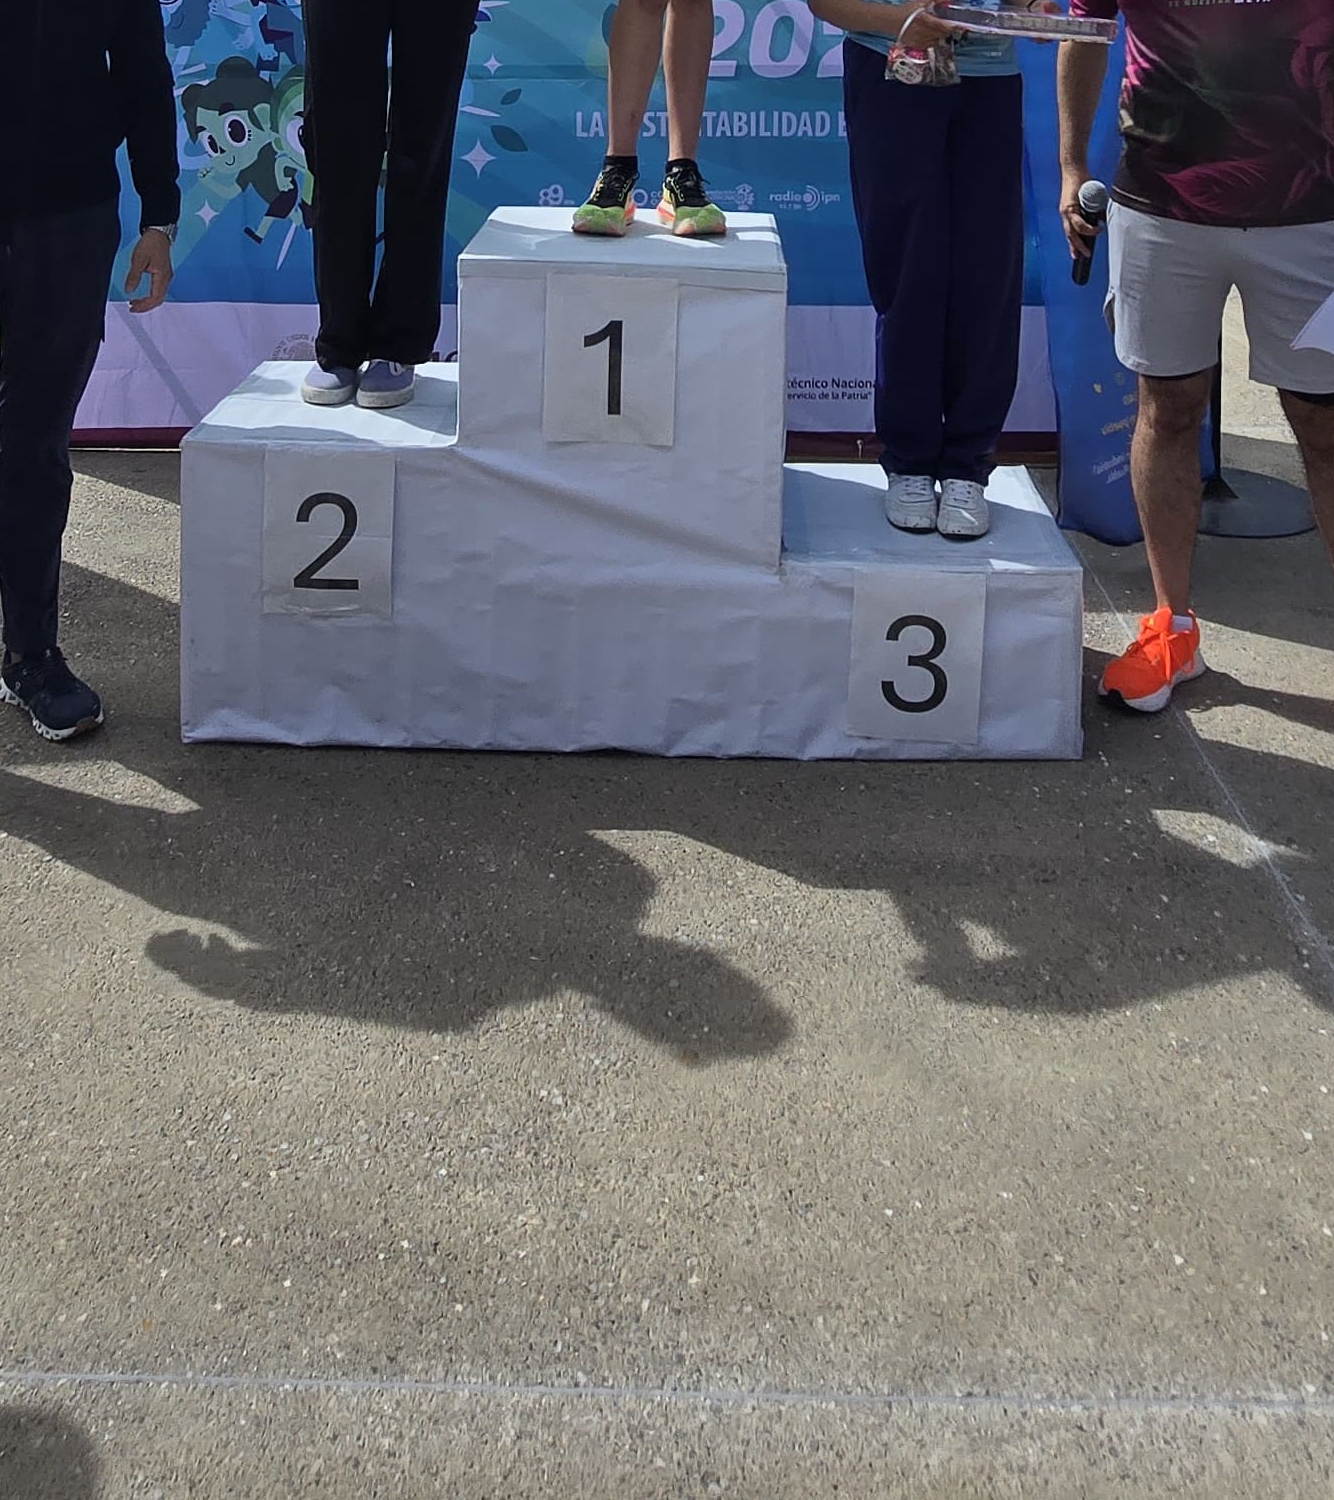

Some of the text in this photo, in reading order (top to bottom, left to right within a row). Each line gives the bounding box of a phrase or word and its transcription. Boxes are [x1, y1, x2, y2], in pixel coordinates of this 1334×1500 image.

[642, 111, 831, 138] STTABILIDAD
[769, 190, 801, 202] radio
[583, 319, 624, 416] 1
[293, 492, 361, 591] 2
[880, 614, 949, 714] 3
